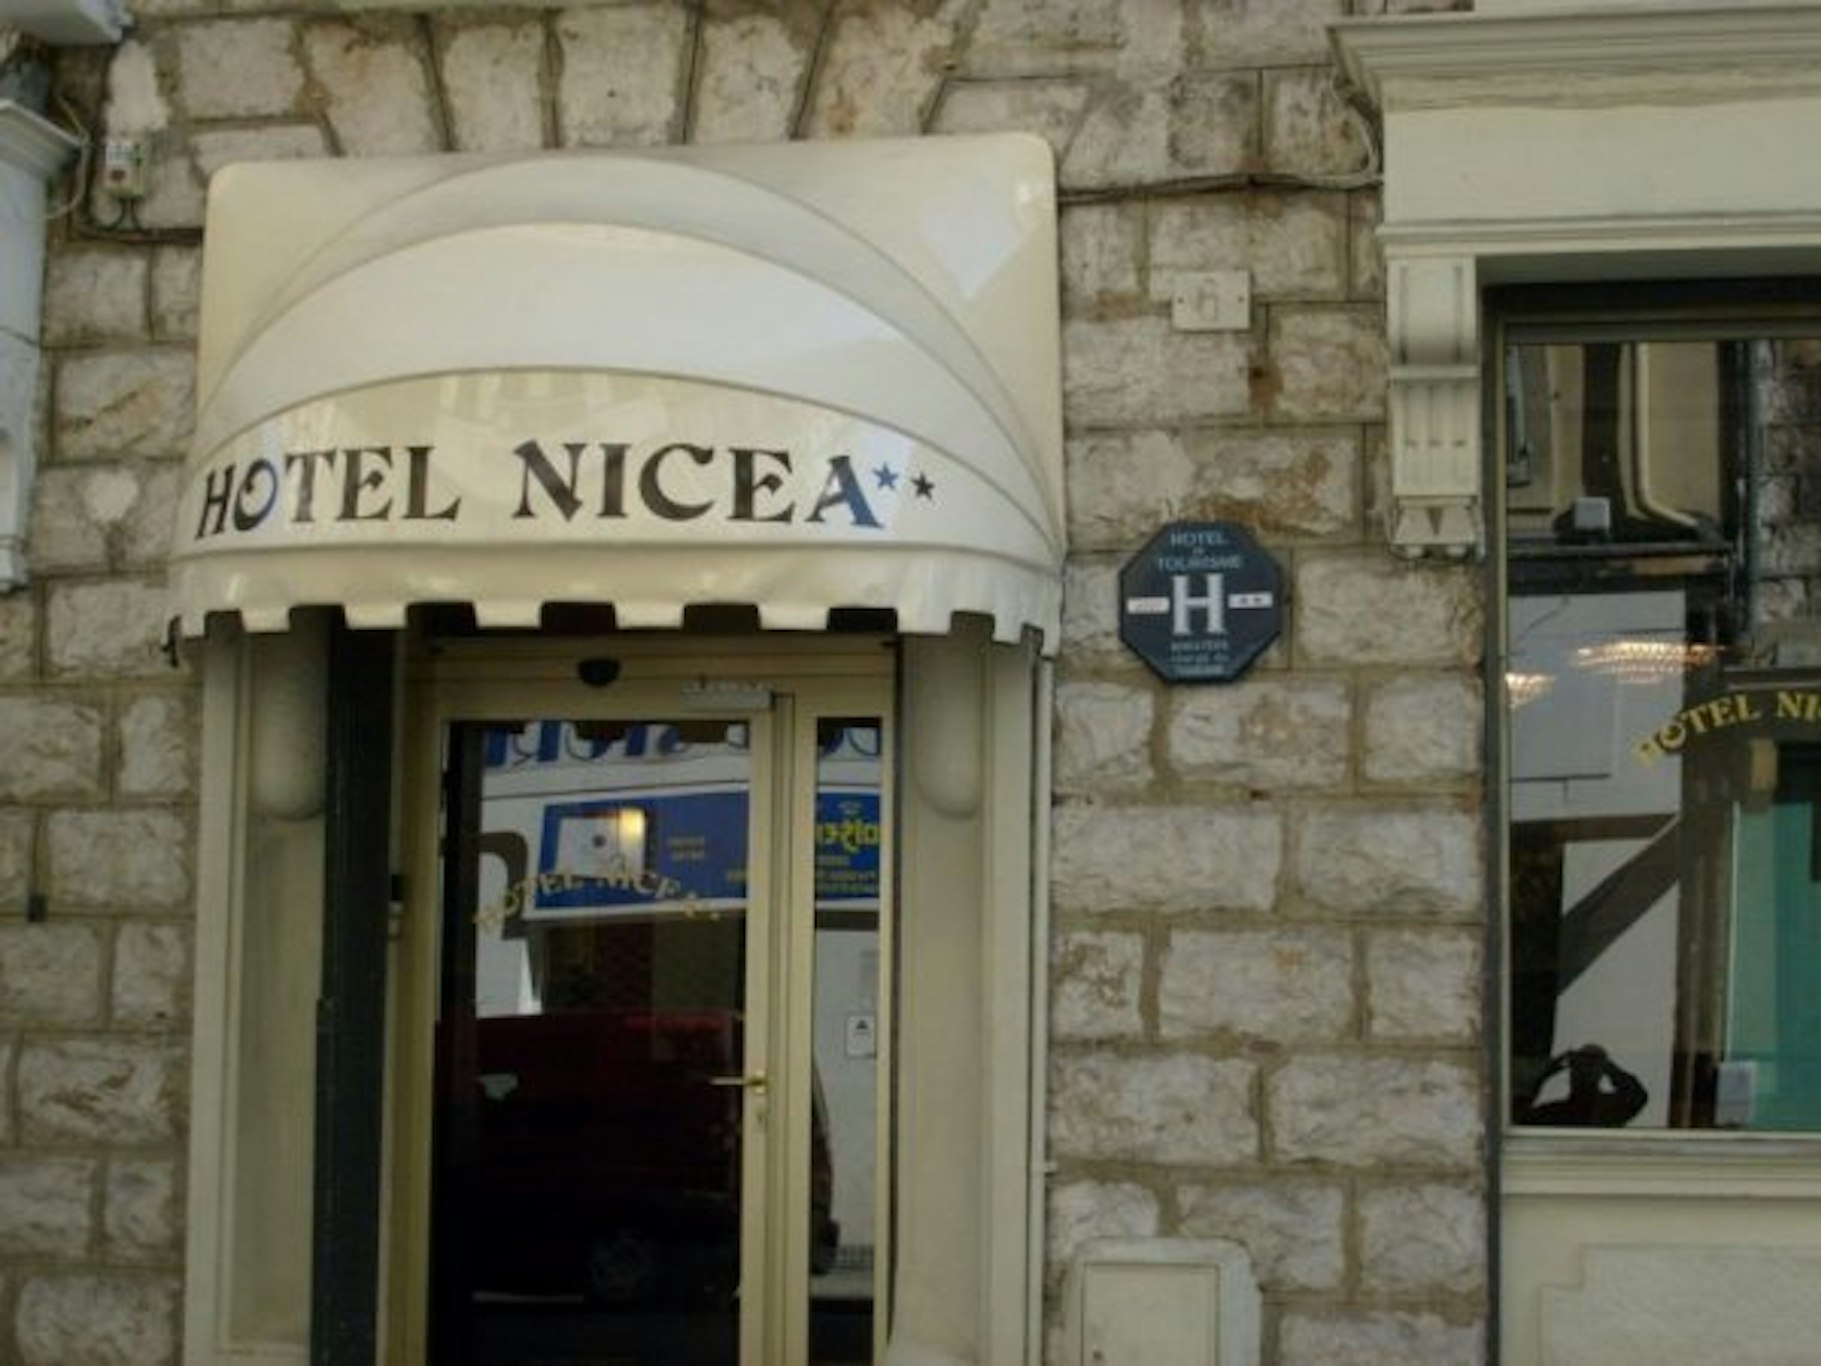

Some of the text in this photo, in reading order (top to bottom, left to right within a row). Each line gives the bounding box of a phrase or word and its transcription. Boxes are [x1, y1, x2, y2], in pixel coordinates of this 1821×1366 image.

[194, 439, 885, 540] HOTEL NICEA
[1172, 572, 1229, 636] H
